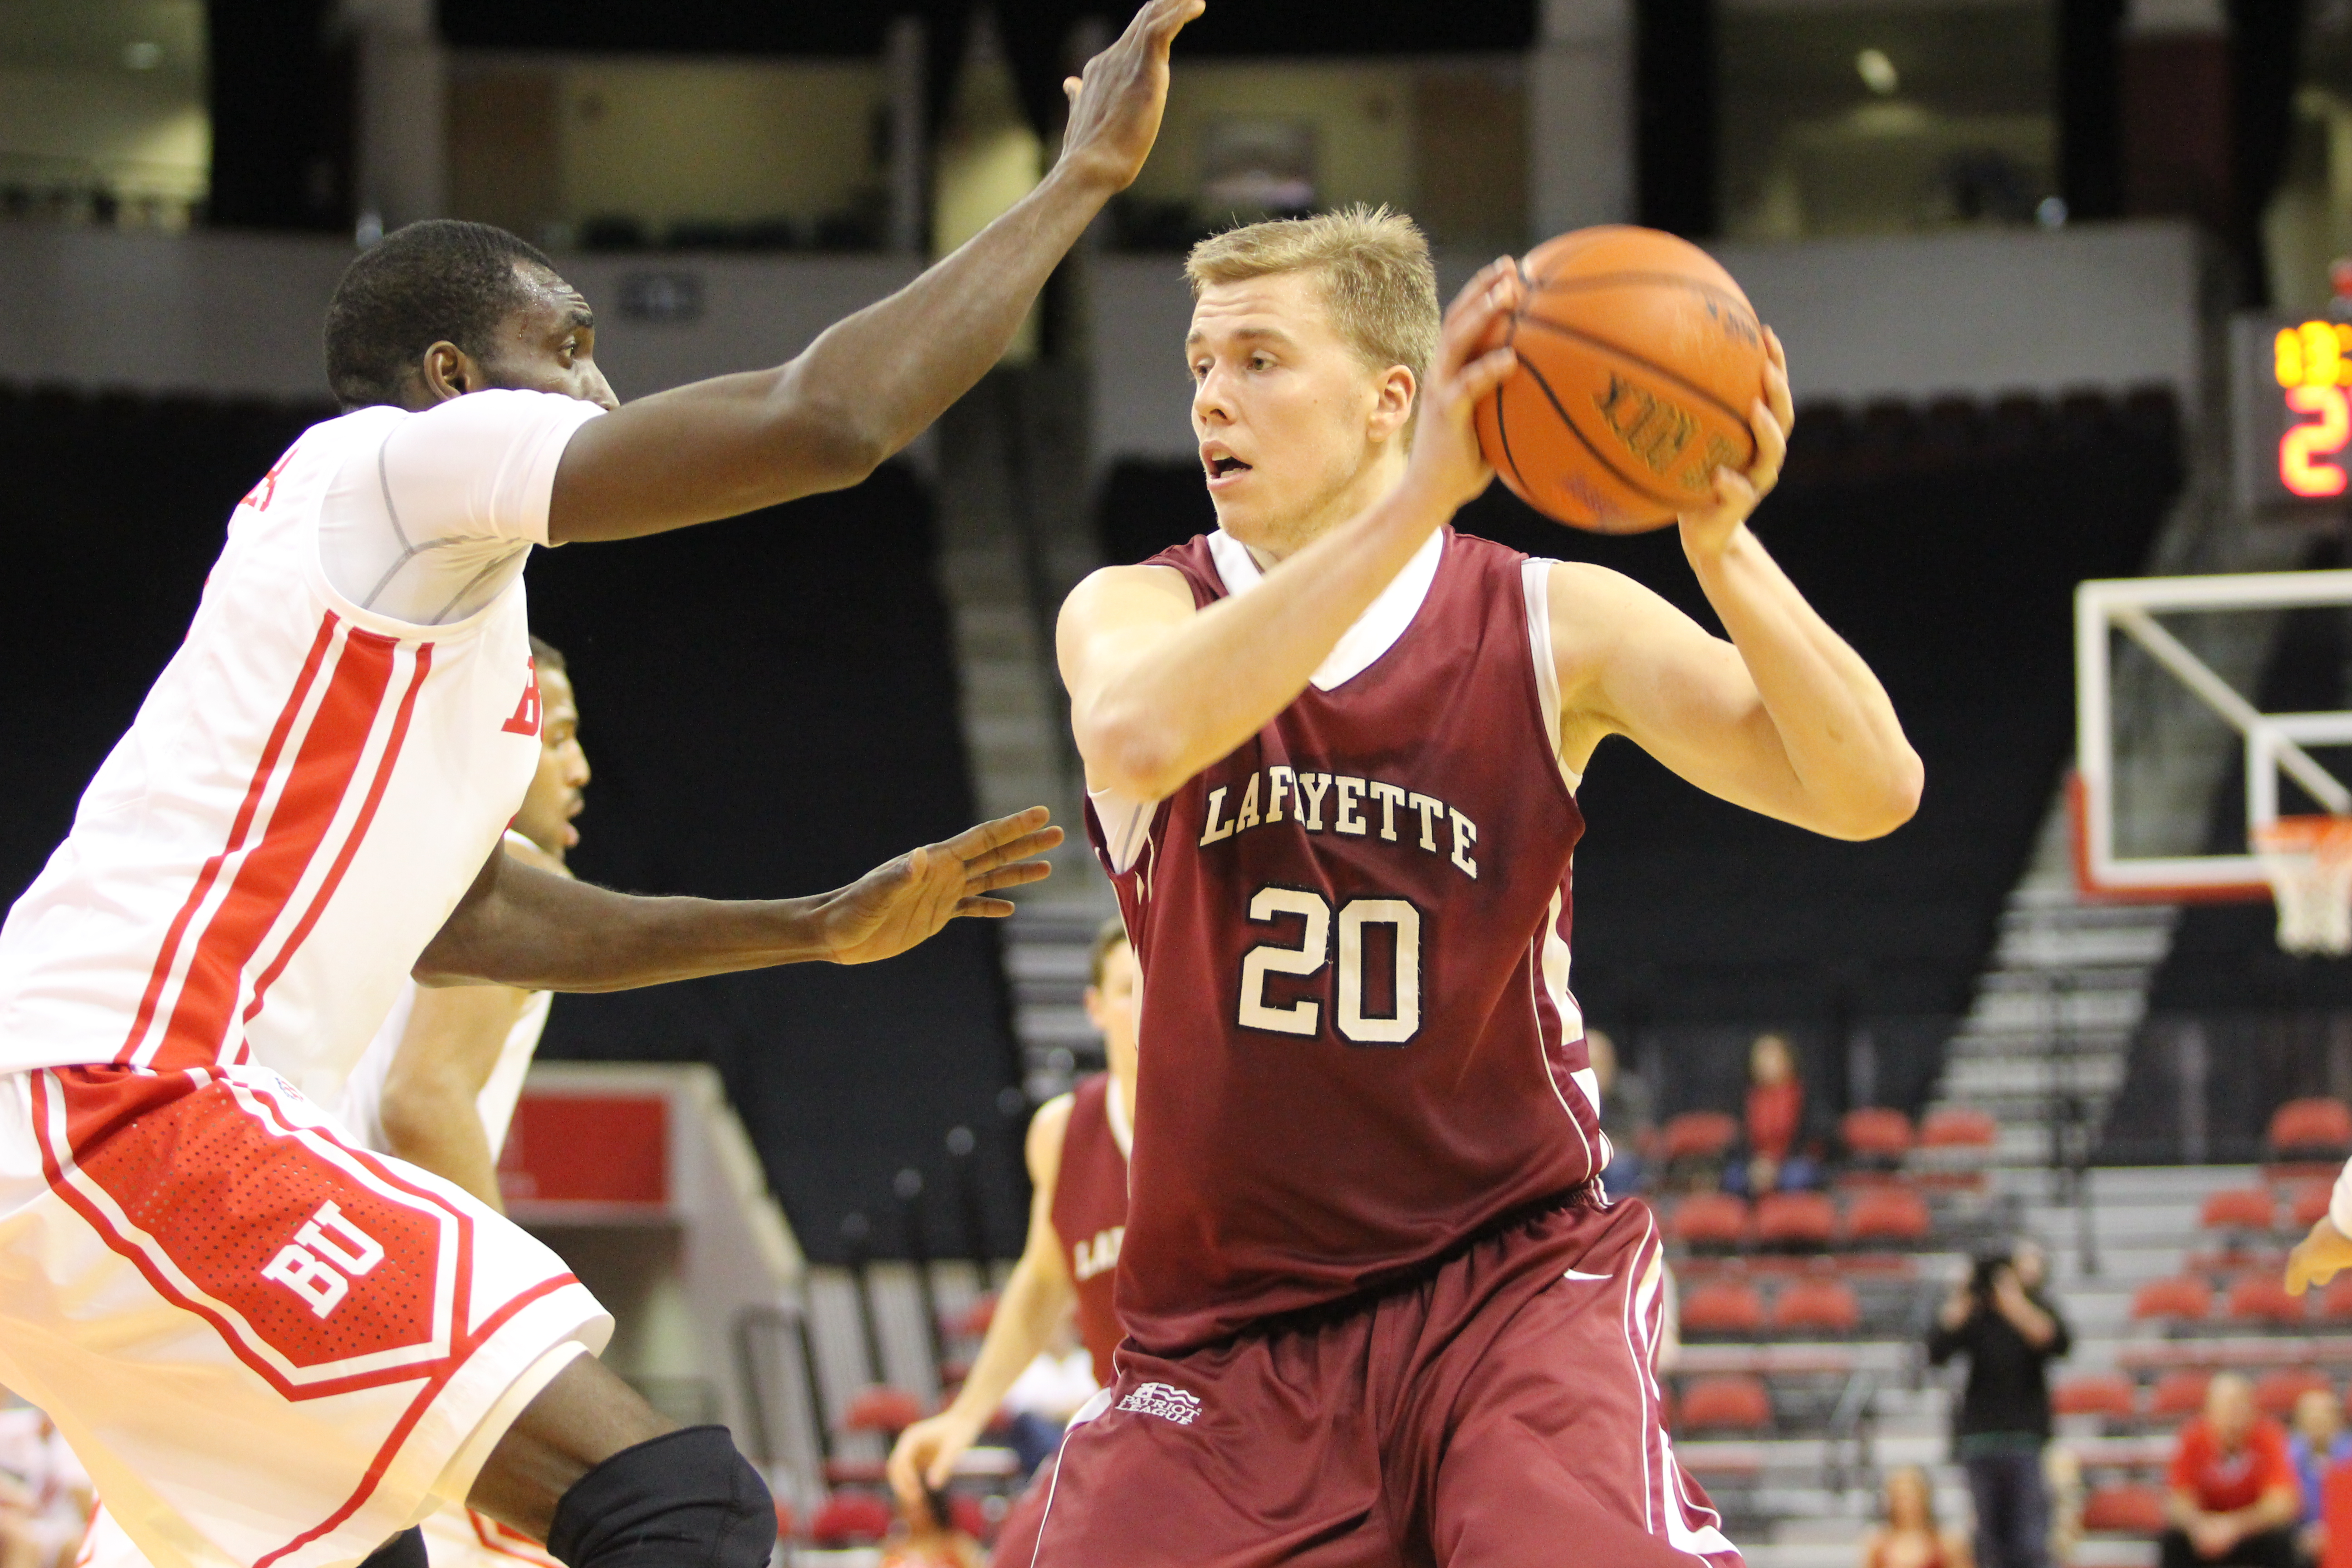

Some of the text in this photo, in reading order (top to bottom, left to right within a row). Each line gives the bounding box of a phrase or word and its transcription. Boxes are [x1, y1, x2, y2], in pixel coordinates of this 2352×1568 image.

[1238, 886, 1421, 1044] 20
[260, 1199, 386, 1320] BU
[1114, 1401, 1193, 1425] LEAGUE
[1121, 1394, 1200, 1419] PATRIOT
